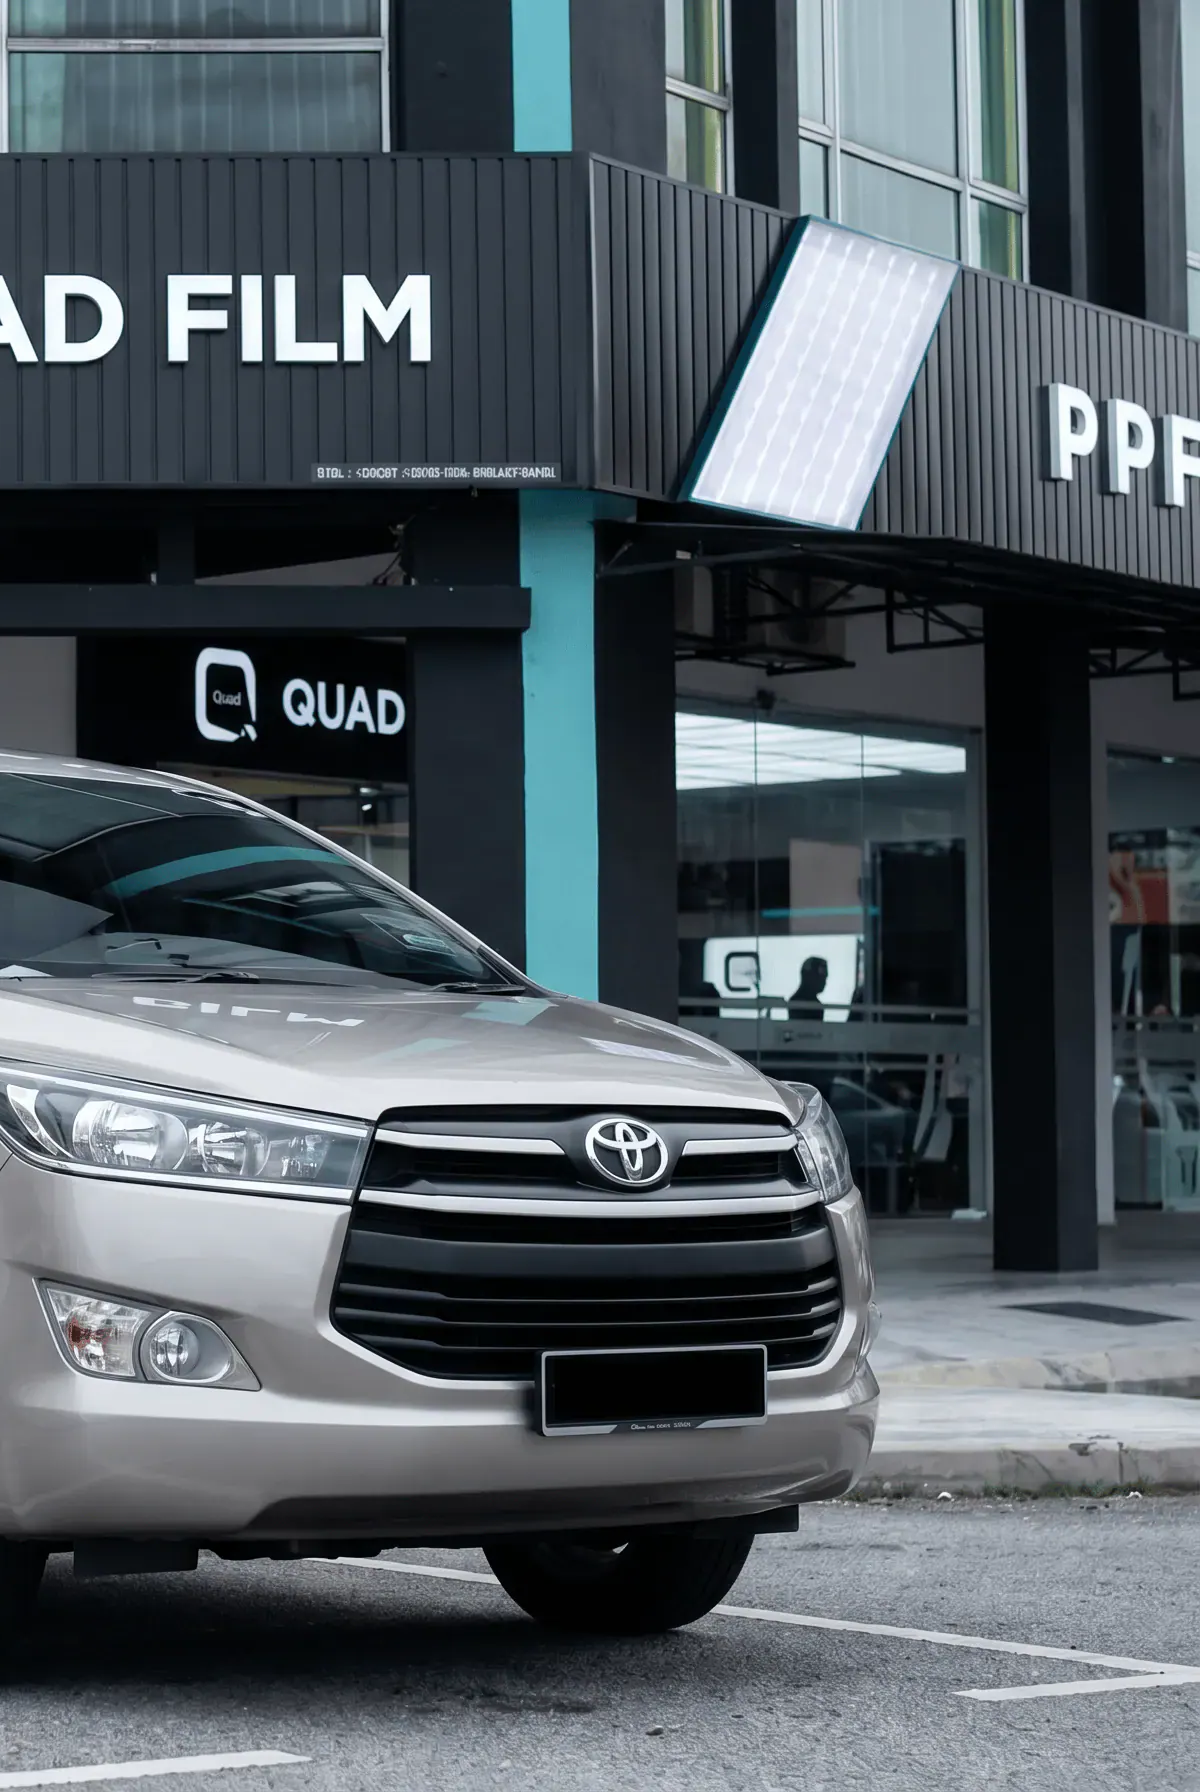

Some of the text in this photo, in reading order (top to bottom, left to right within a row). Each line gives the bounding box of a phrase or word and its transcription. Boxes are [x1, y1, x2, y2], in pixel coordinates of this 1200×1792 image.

[166, 273, 433, 363] FILM
[1049, 382, 1200, 508] PPF
[282, 678, 406, 736] QUAD
